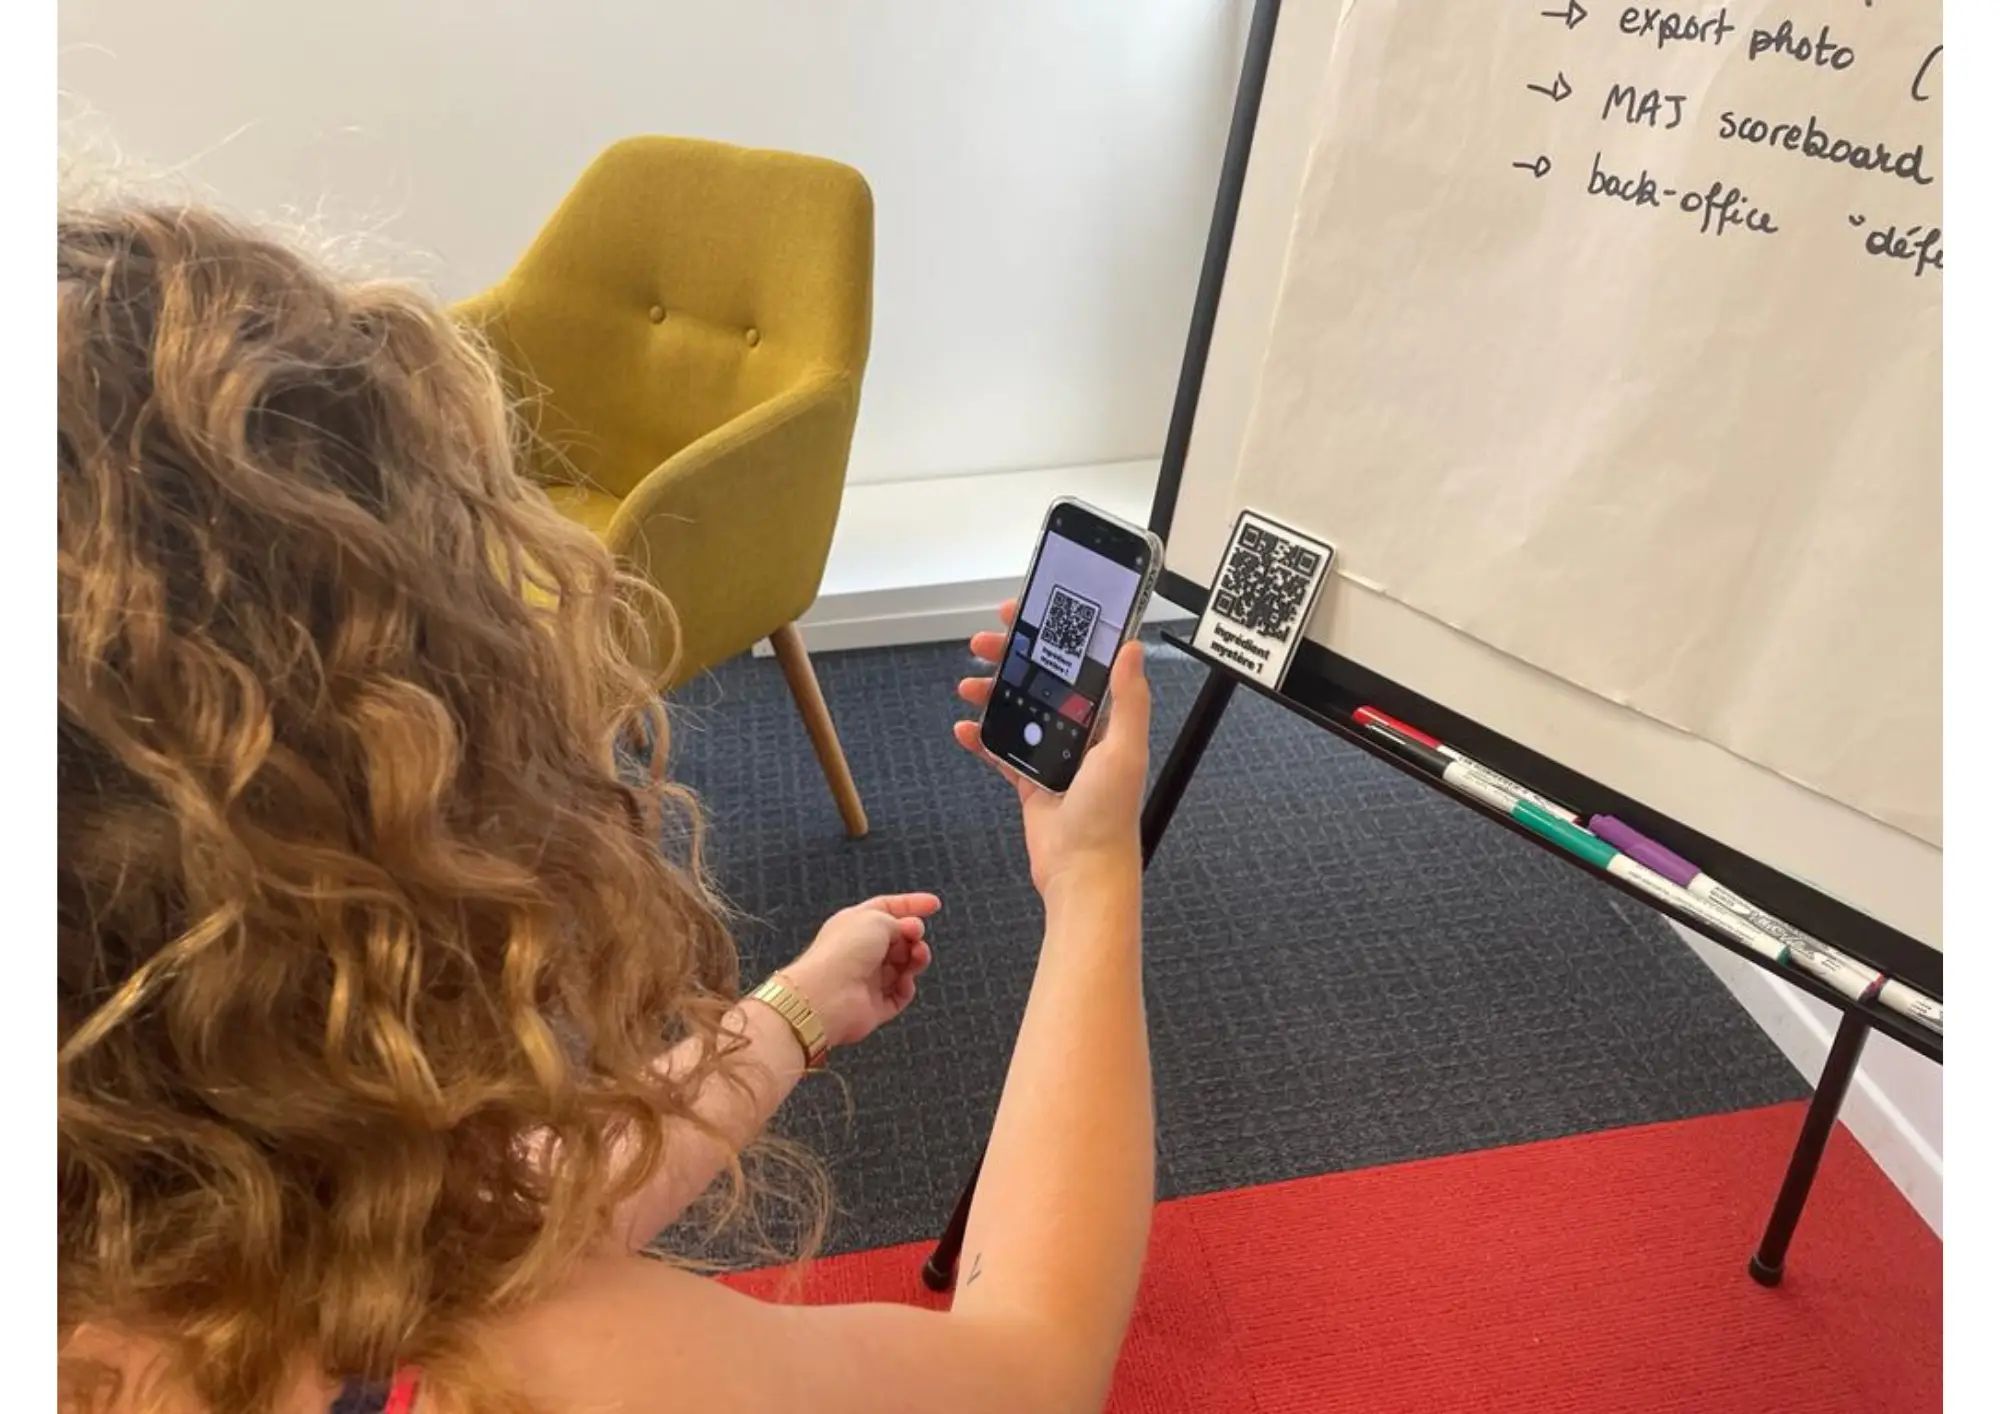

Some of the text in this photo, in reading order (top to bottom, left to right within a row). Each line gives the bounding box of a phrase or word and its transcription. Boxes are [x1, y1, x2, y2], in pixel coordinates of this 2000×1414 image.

[1619, 6, 1736, 50] export
[1748, 19, 1855, 71] photo
[1601, 83, 1934, 185] MAJ scoreboard
[1587, 151, 1779, 237] back-office
